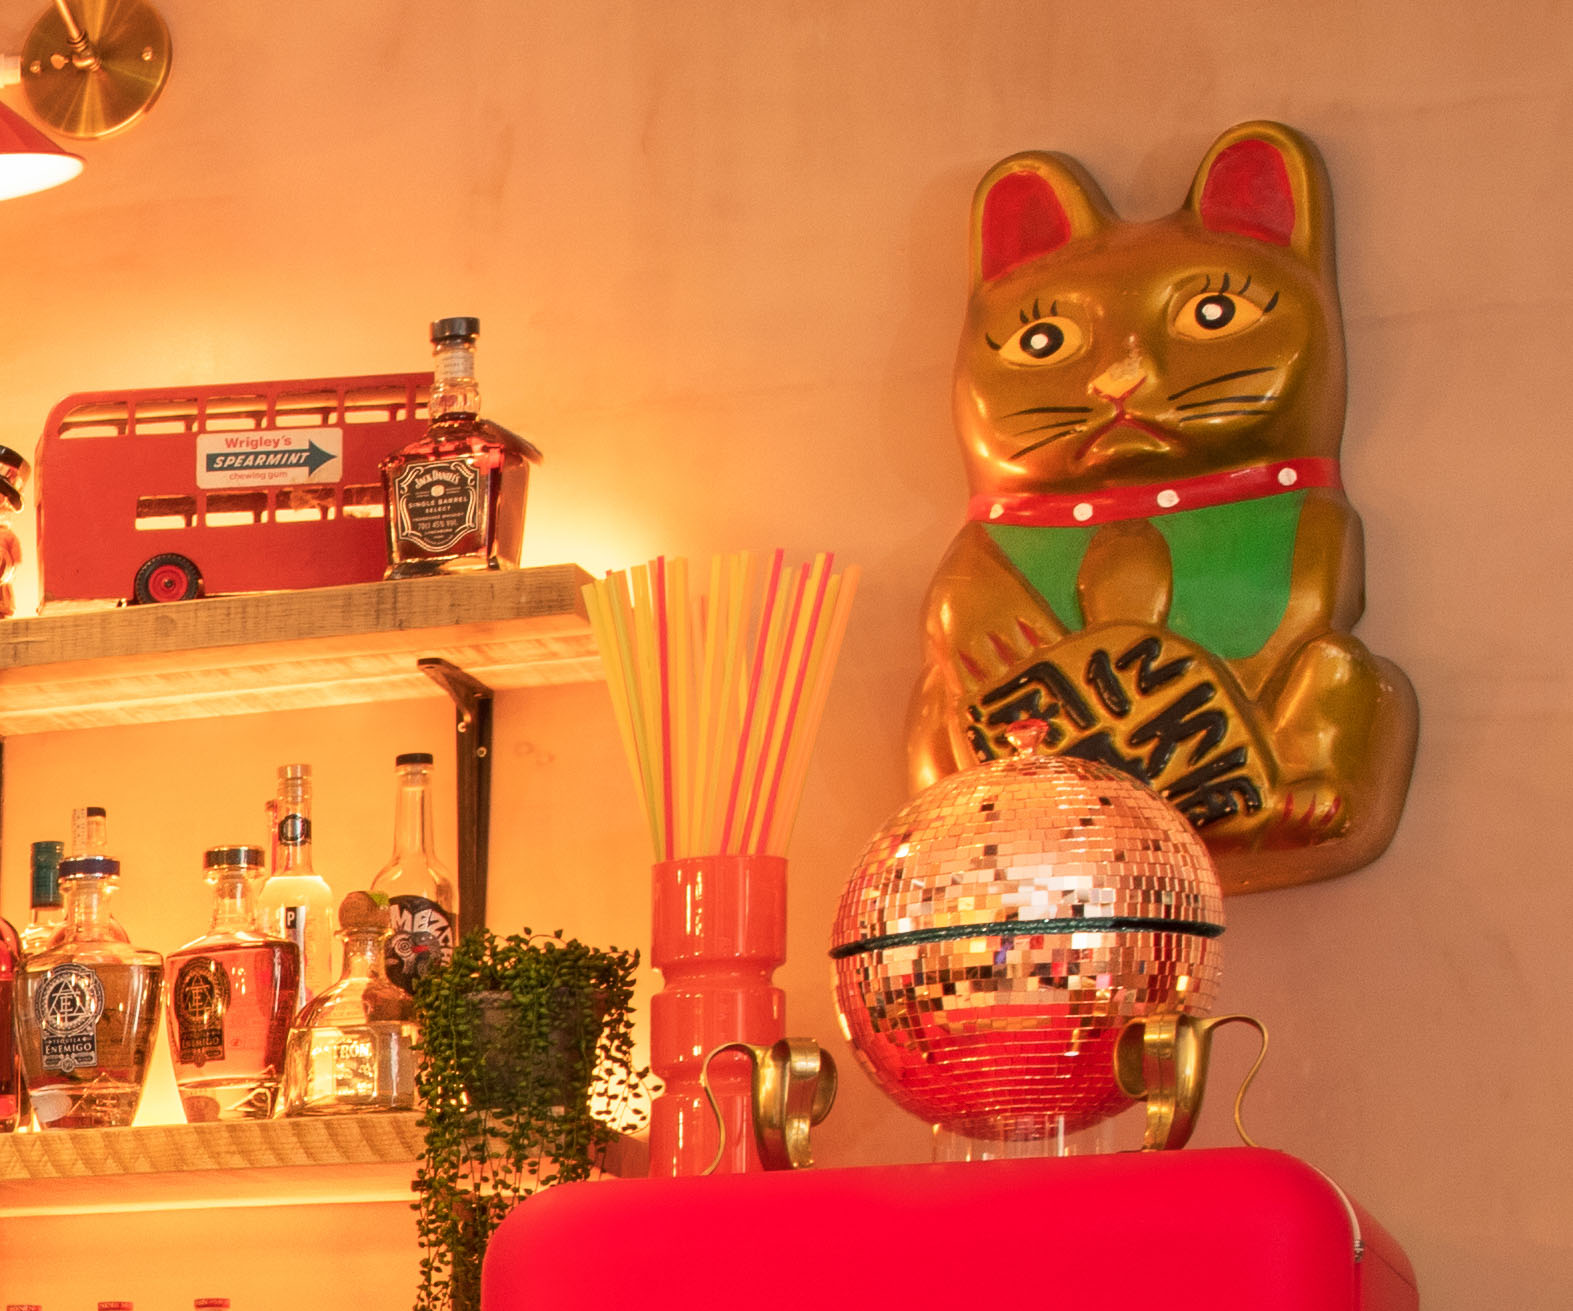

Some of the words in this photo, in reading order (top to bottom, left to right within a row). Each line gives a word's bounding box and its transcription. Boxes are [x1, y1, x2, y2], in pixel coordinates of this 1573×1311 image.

[224, 435, 292, 450] Wrigley's
[213, 451, 310, 469] SPEARMINT
[229, 471, 265, 481] chewing
[267, 469, 288, 480] gum
[45, 1043, 92, 1054] ENEMIGO
